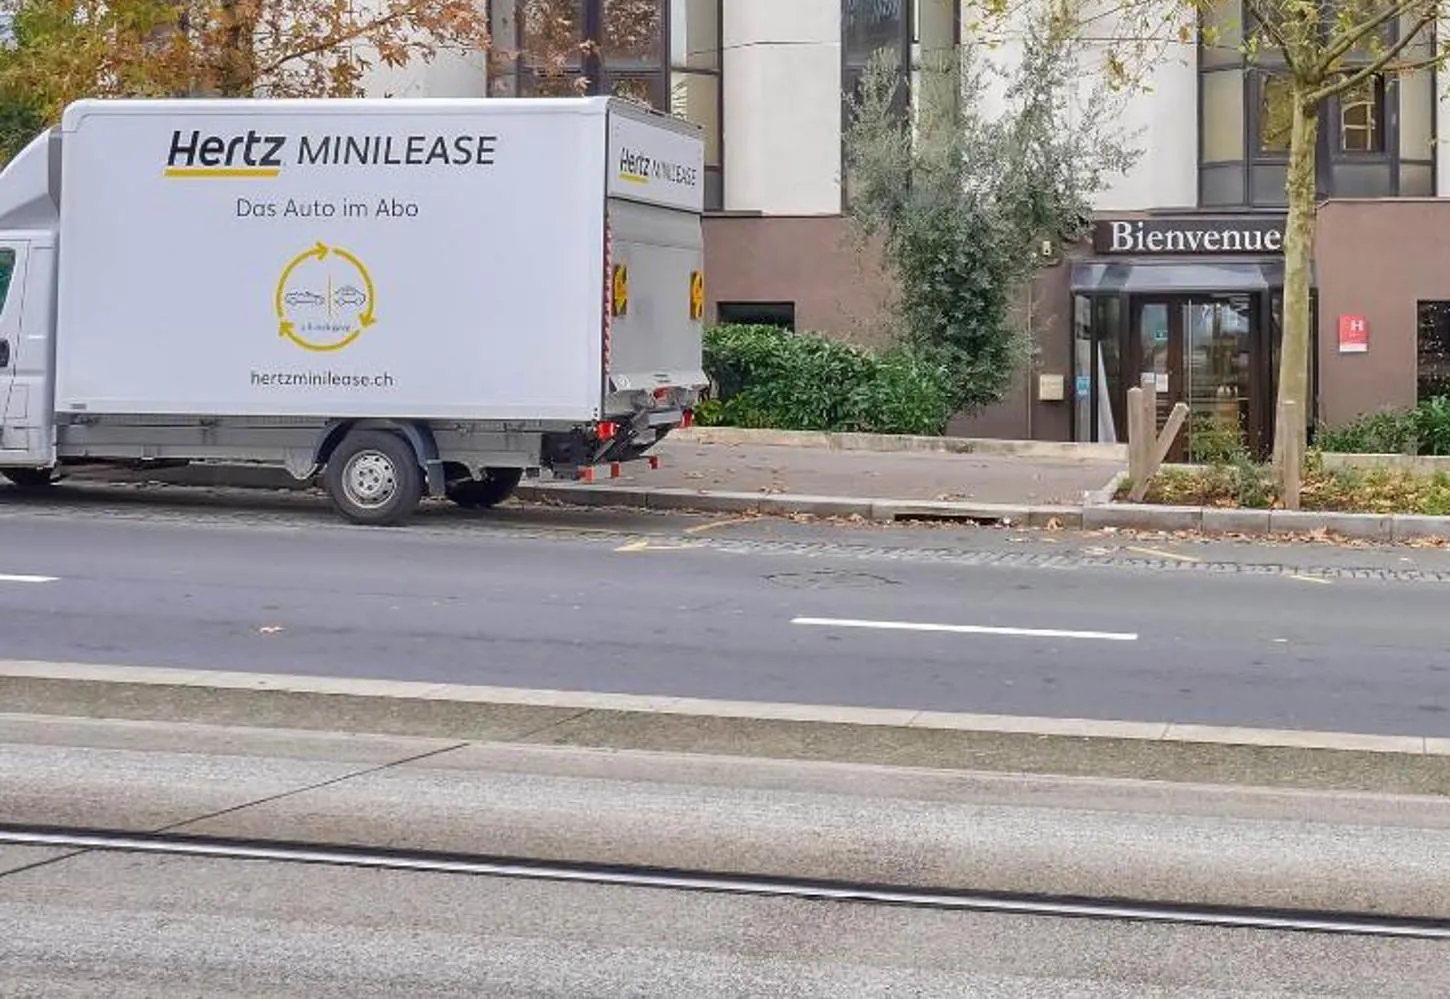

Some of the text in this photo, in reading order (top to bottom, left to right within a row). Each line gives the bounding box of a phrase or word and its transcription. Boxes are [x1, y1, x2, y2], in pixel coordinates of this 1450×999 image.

[167, 130, 497, 166] Hertz MINILEASE
[236, 198, 419, 217] Das Auto im Abo
[1109, 220, 1282, 251] Bienvenue
[250, 370, 394, 387] hertzminilease.ch
